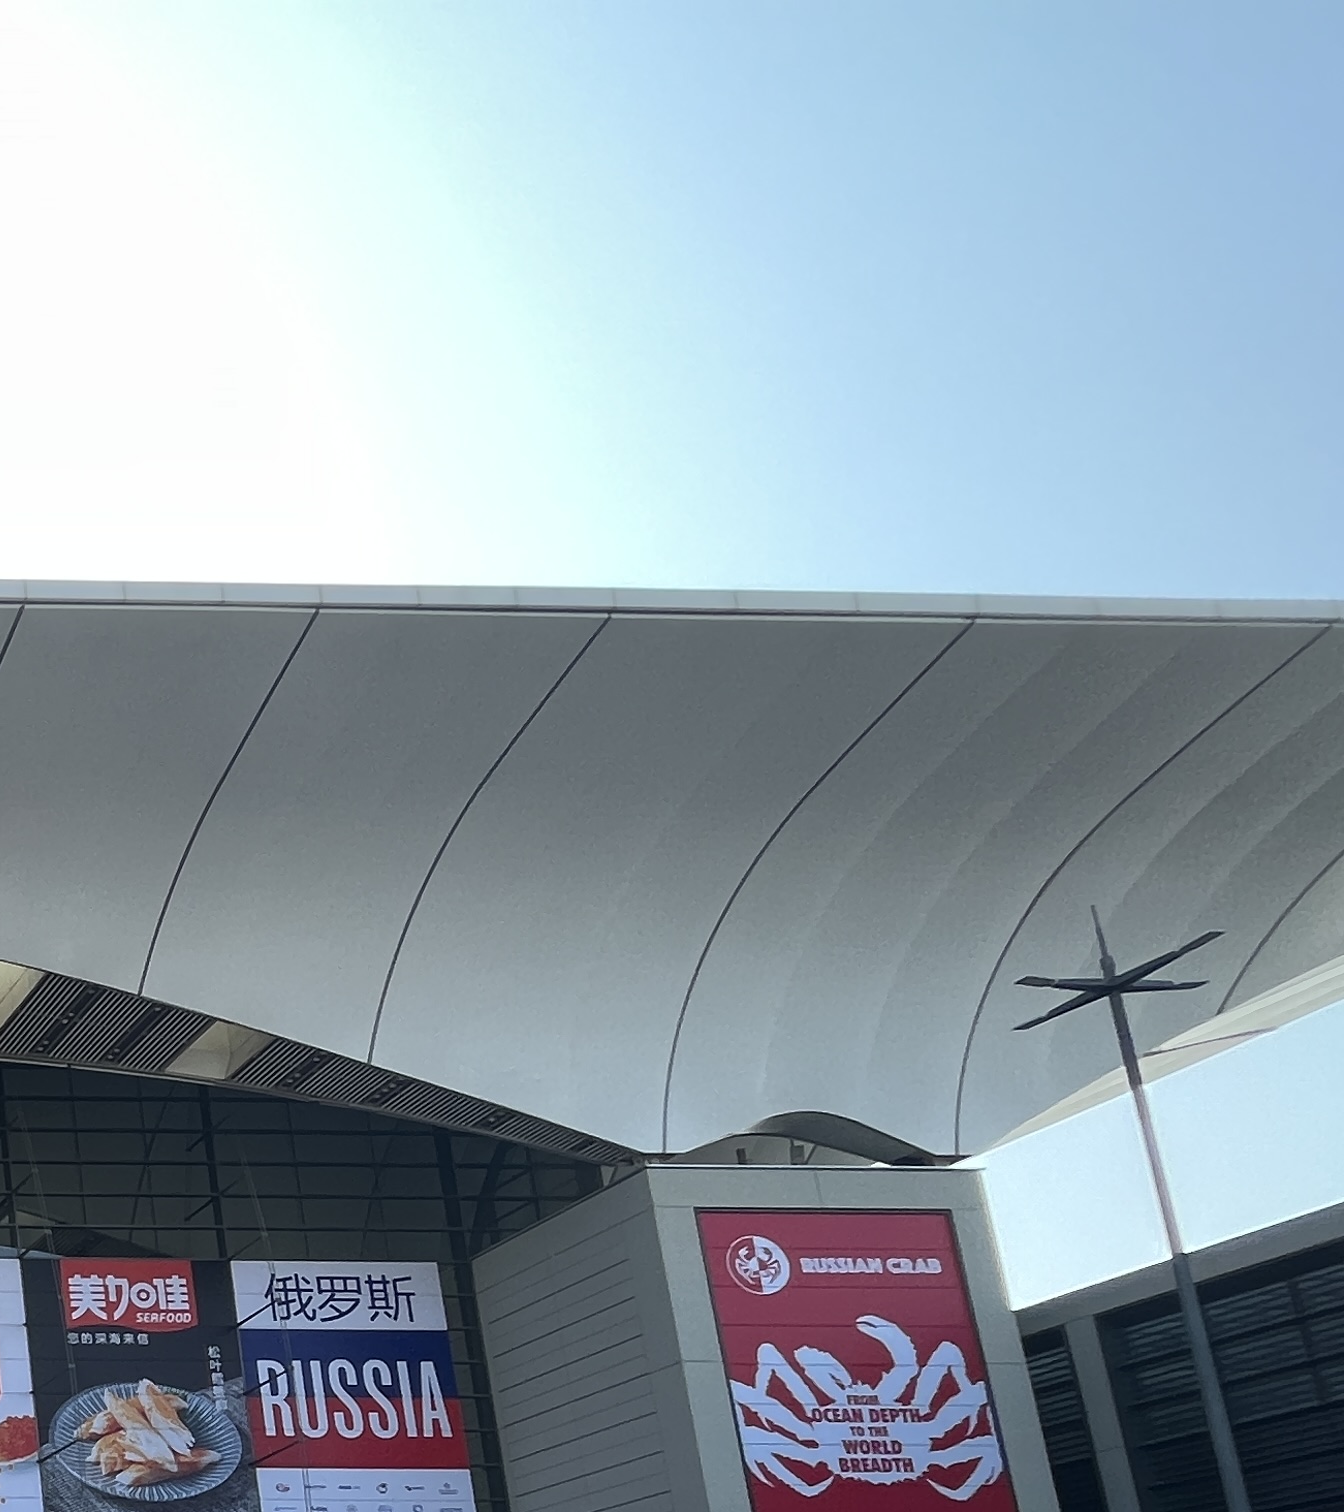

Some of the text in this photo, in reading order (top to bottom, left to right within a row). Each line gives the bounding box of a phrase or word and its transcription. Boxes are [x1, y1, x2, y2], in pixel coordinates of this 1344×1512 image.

[800, 1257, 942, 1274] RUSSIAN CRAB
[264, 1272, 417, 1323] 俄罗斯
[135, 1312, 192, 1323] SEAFOOD
[256, 1358, 454, 1439] RUSSIA
[812, 1408, 922, 1422] OCEAN DEPTH
[849, 1426, 889, 1436] TO THE
[841, 1440, 903, 1454] WORLD
[838, 1458, 915, 1472] BREADTH
